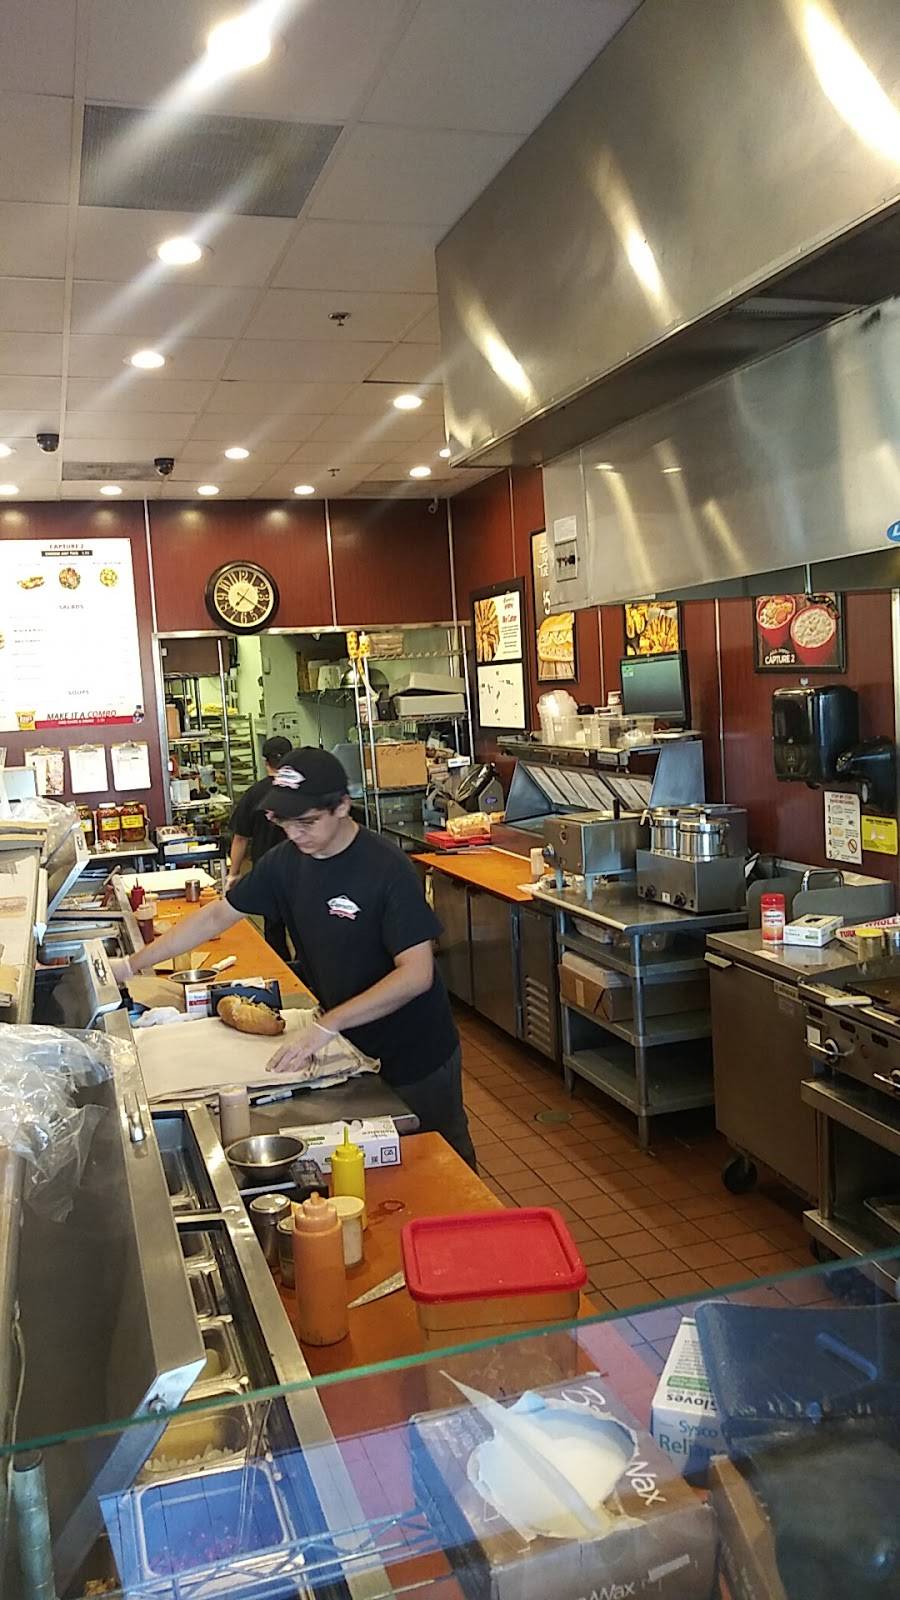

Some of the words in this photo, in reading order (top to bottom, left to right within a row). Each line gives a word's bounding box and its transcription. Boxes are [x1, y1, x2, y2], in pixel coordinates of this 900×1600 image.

[764, 655, 790, 665] CAPTURE
[790, 654, 796, 664] 2
[47, 712, 69, 721] MAKE
[87, 709, 117, 719] COMBO
[678, 1419, 718, 1439] Sysco
